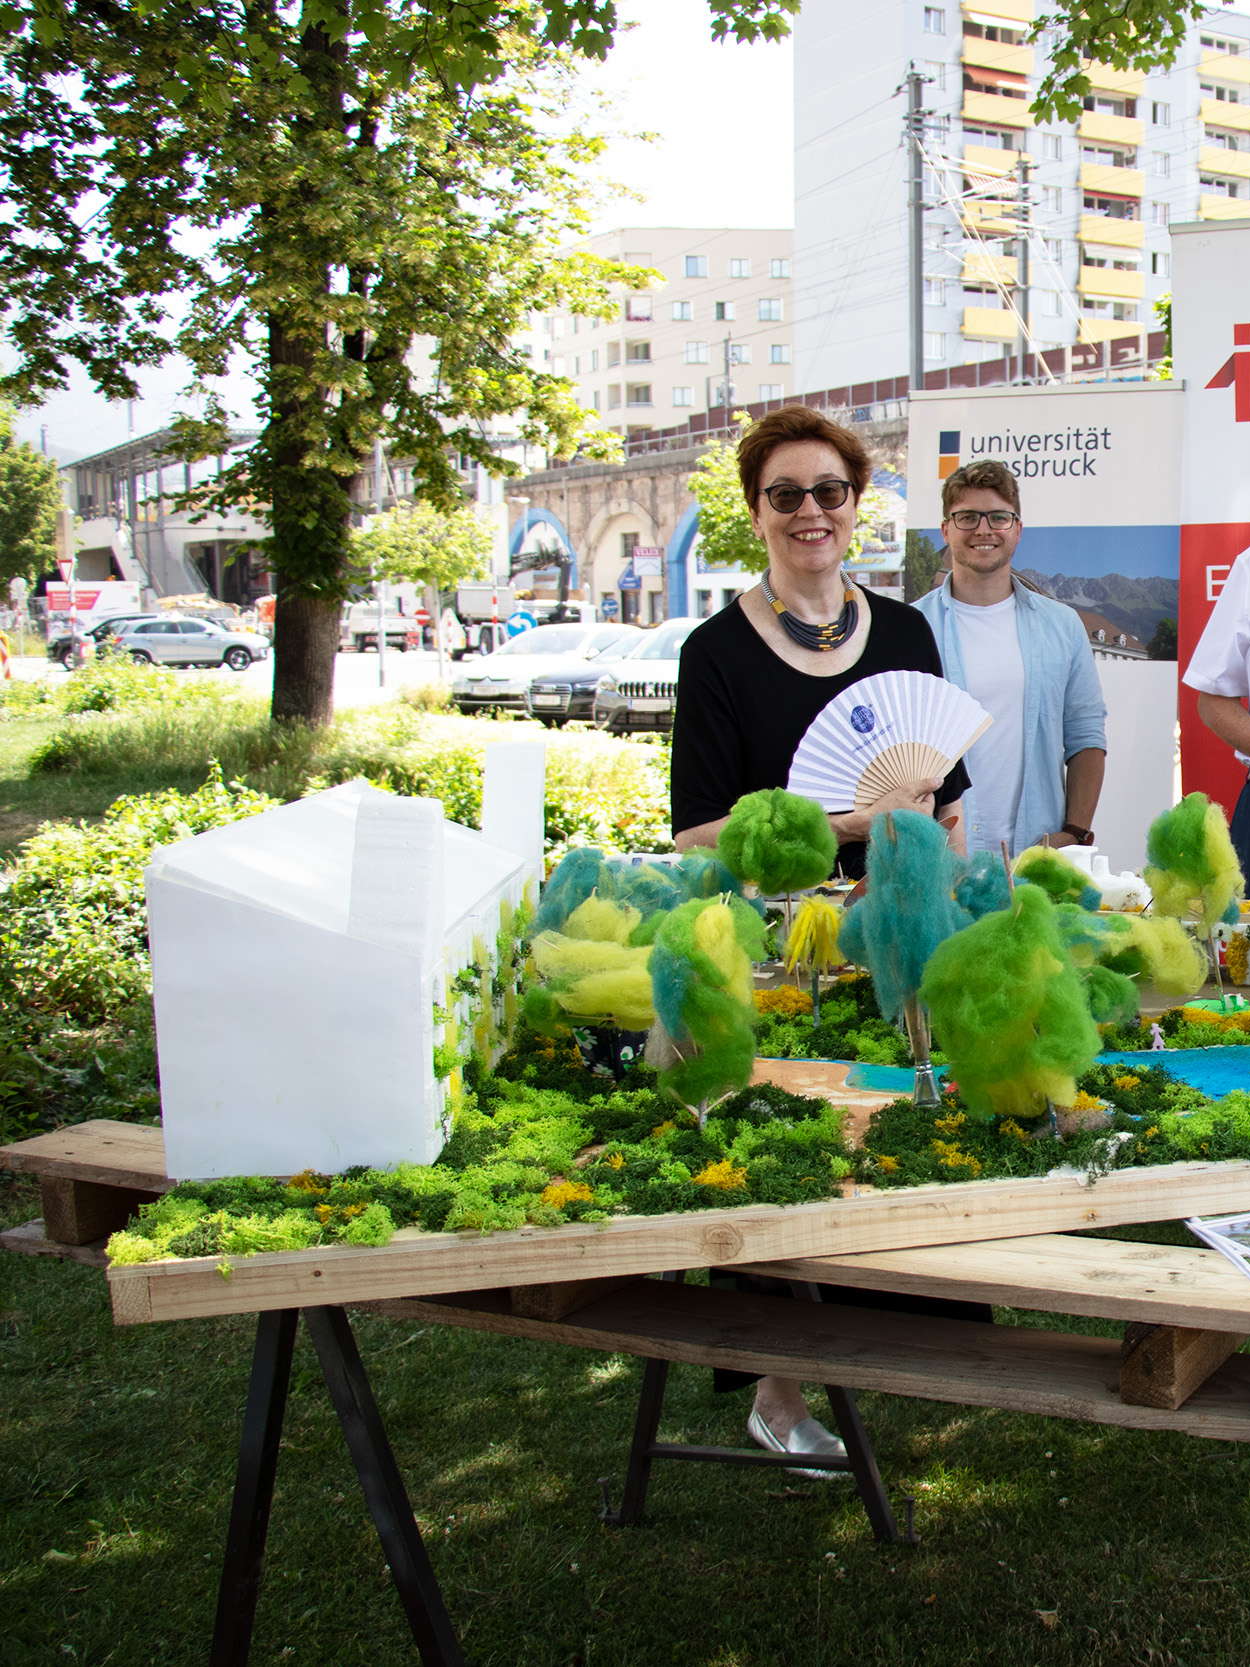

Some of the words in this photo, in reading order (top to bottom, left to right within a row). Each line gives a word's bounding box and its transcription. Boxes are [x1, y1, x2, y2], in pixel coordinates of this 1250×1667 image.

[970, 426, 1112, 454] universität
[970, 452, 1097, 478] sbruck
[1205, 564, 1231, 601] E
